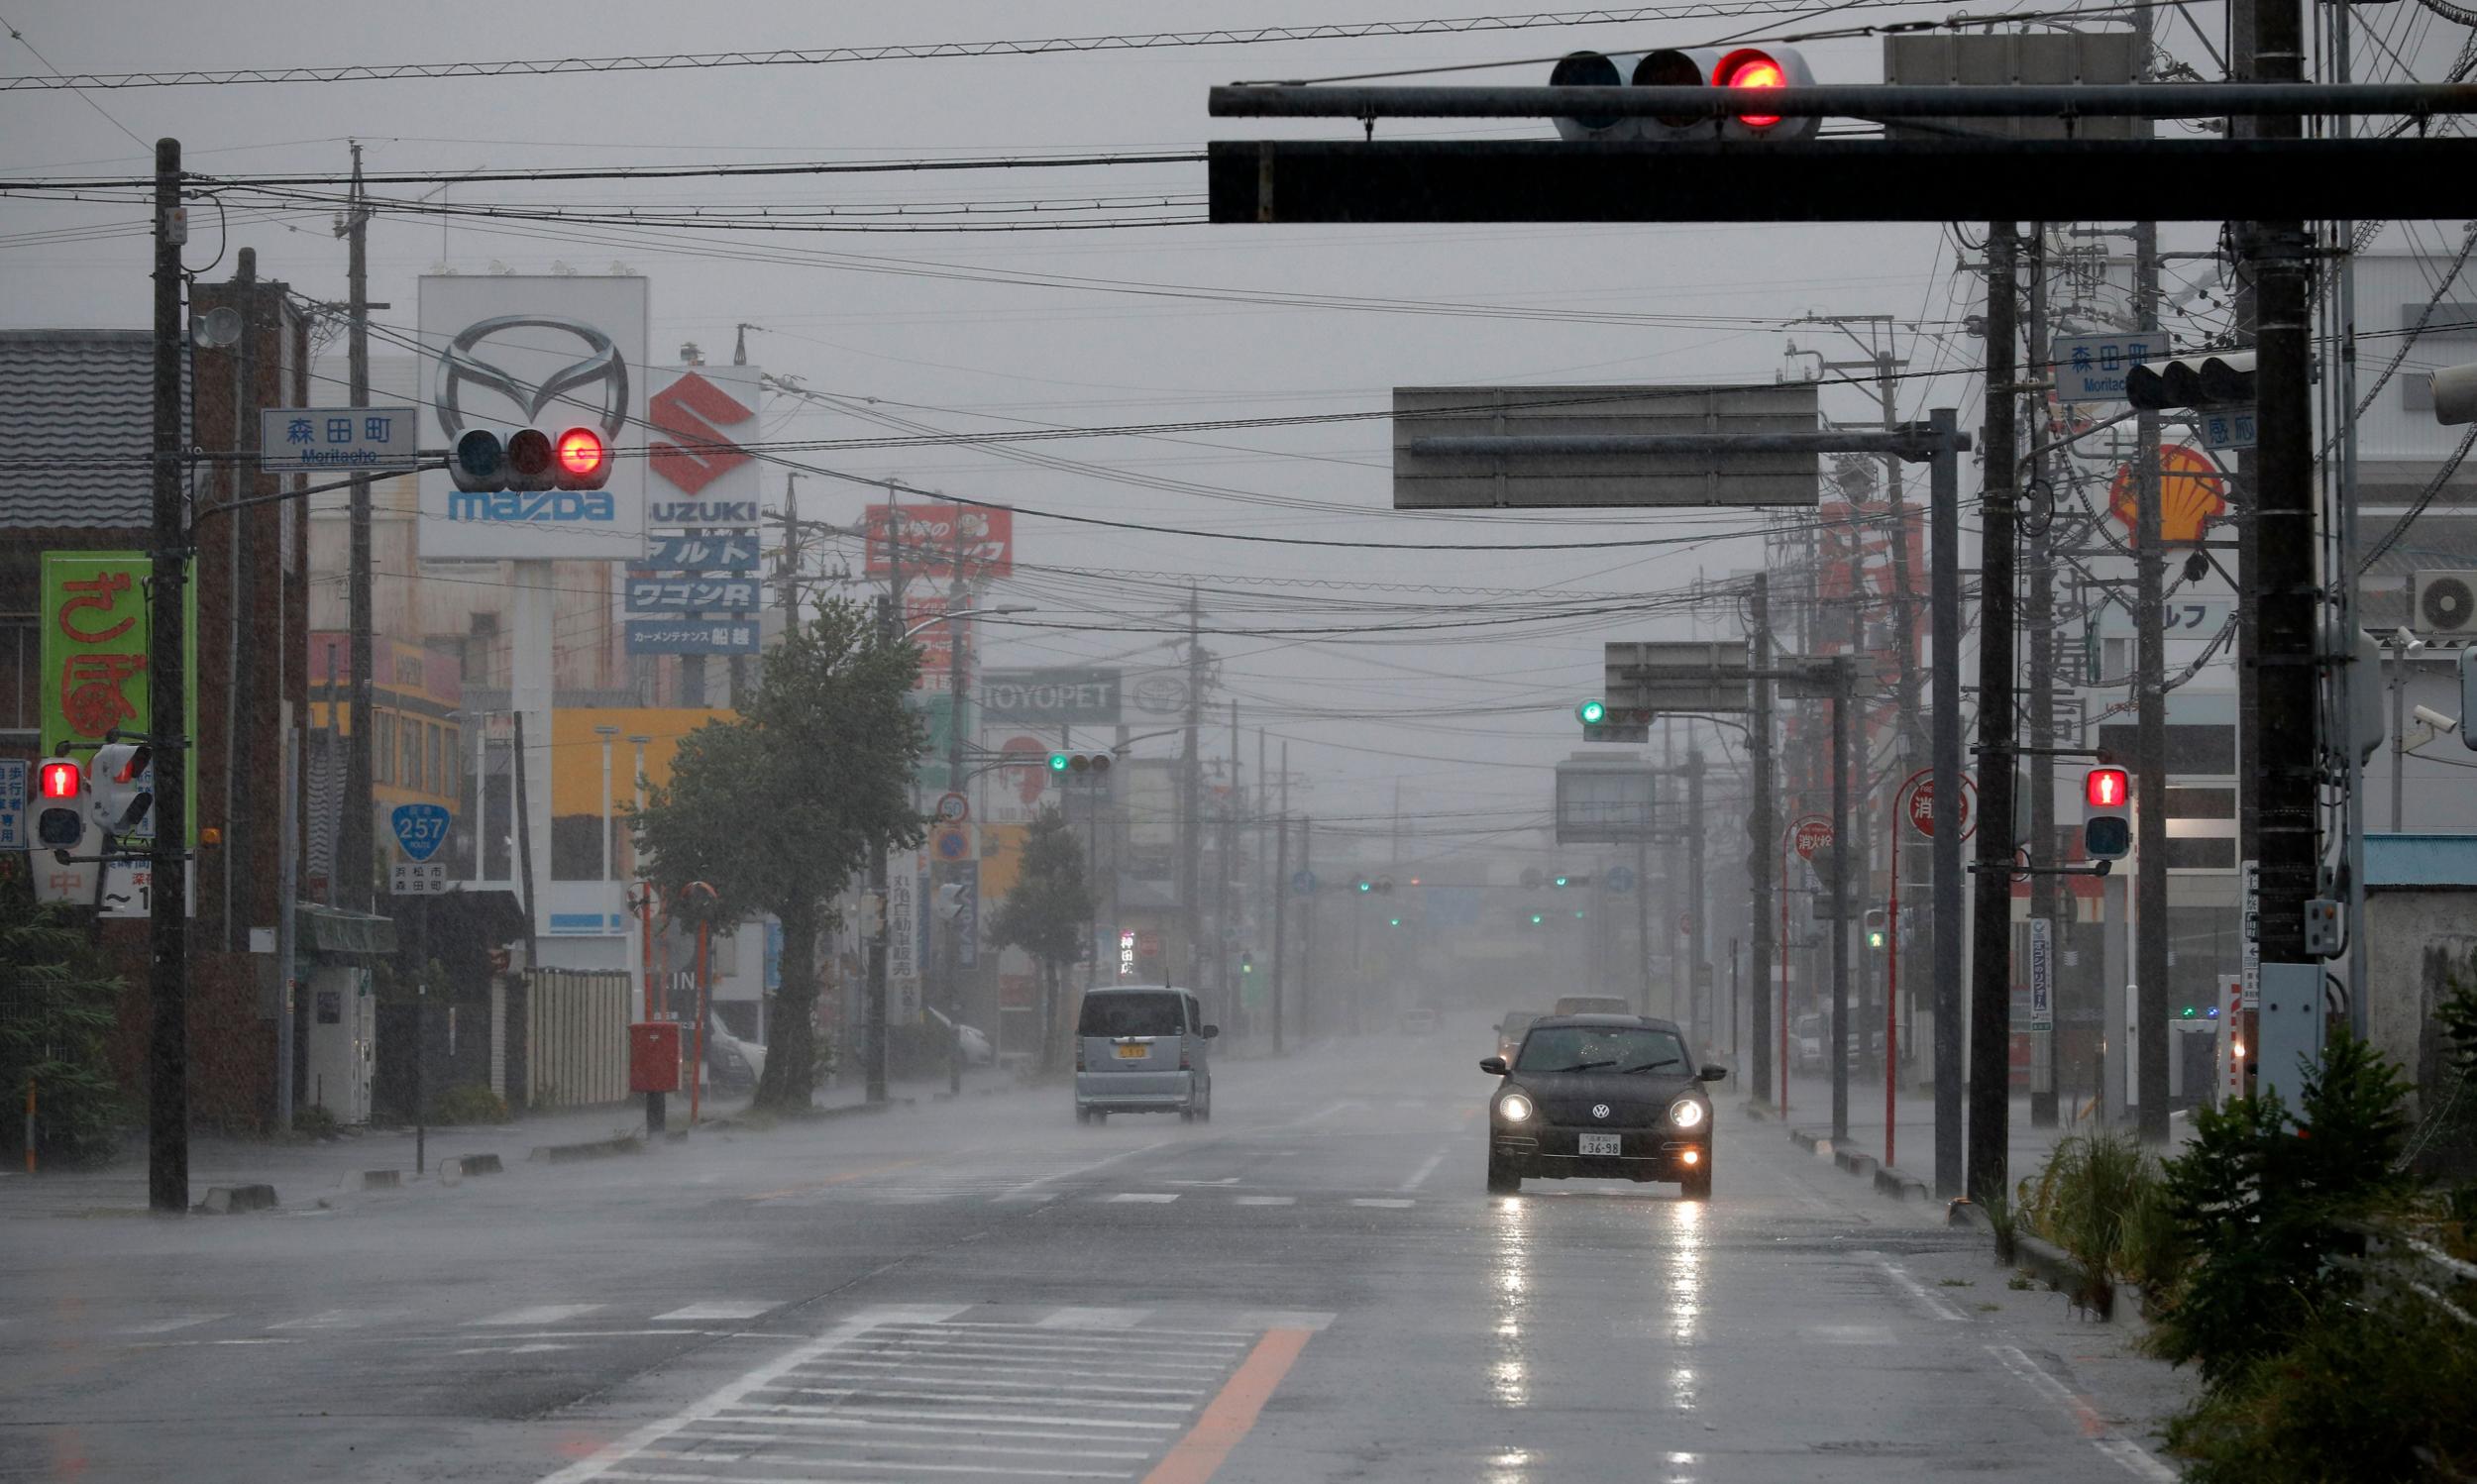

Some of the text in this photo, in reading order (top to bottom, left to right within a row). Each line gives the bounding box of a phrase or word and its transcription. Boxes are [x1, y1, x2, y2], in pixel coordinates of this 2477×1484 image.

[2071, 344, 2149, 372] 森田町
[2084, 376, 2127, 392] Moritac
[286, 417, 391, 445] 森田町
[301, 449, 377, 463] Moritacho
[649, 502, 756, 522] UZUKI
[634, 583, 752, 606] ワゴンR
[2132, 605, 2206, 629] ルフ
[634, 631, 709, 643] カーメンテナンス
[59, 572, 148, 778] ざぼ
[982, 684, 1113, 708] TOYOPET
[9, 767, 22, 810] 歩行者
[944, 801, 962, 815] 50
[2, 814, 14, 842] 専用
[399, 817, 444, 839] 257
[1799, 834, 1833, 850] 消火栓
[395, 866, 442, 877] 浜松市
[395, 880, 442, 892] 森田町
[1588, 1142, 1618, 1154] 36-98
